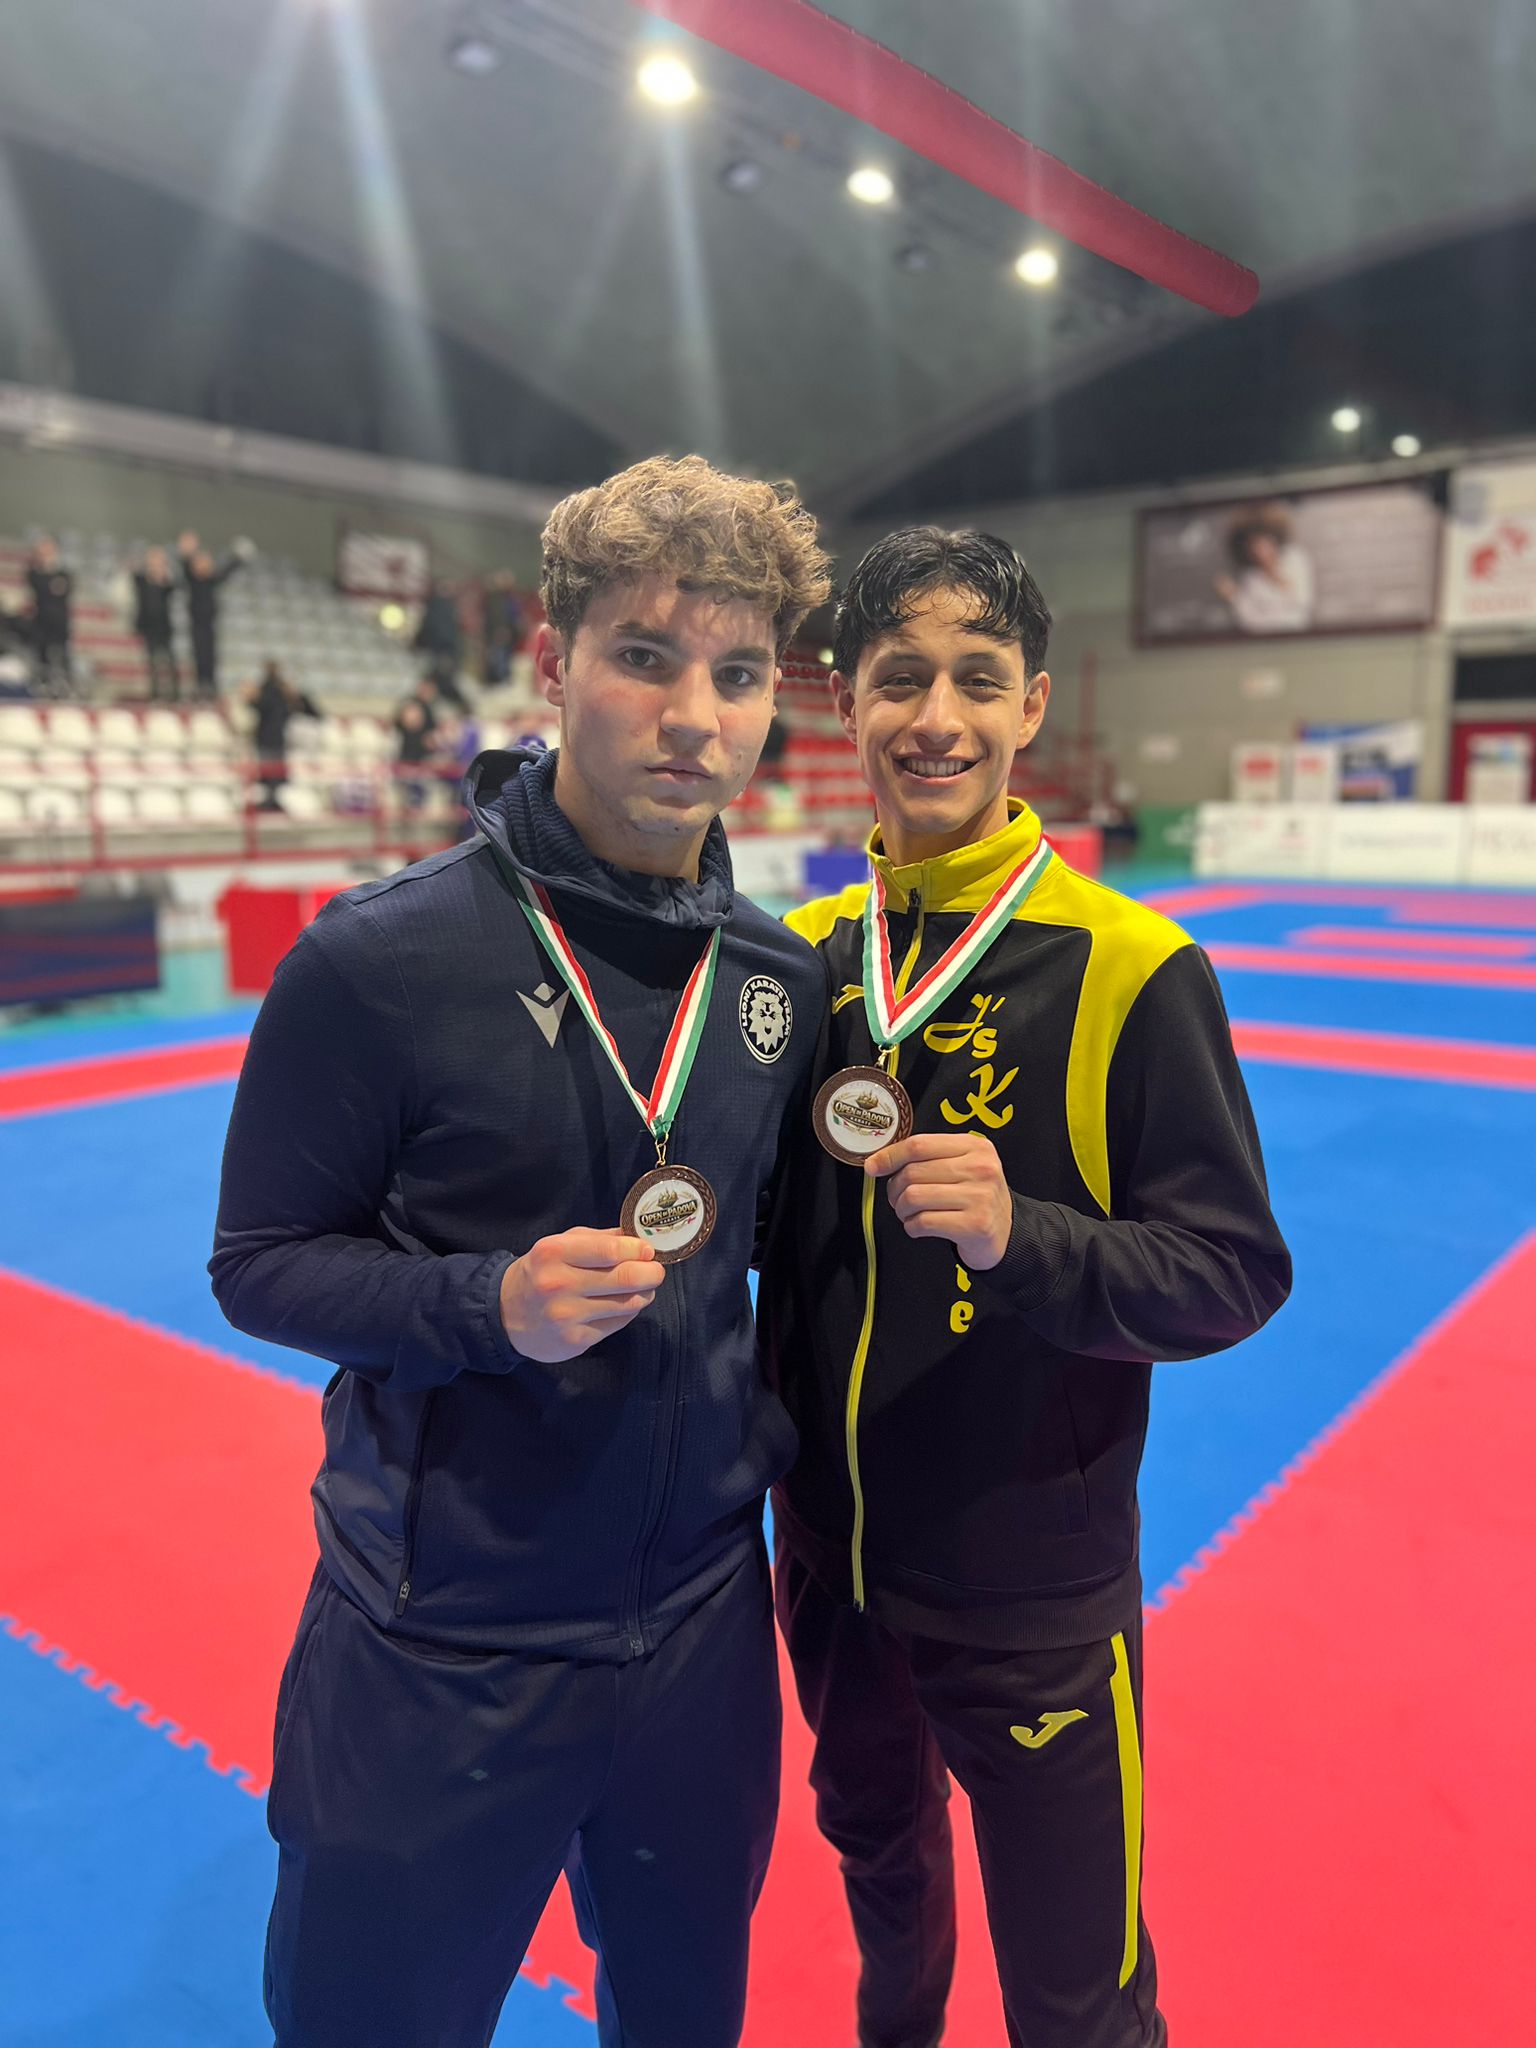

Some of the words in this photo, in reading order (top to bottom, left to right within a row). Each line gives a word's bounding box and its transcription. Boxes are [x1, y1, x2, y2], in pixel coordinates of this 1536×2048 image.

[741, 988, 752, 1027] LEONI
[750, 978, 785, 999] KARATE
[835, 1101, 856, 1116] OPEN
[861, 1109, 891, 1127] PADOVA
[641, 1210, 664, 1225] OPEN
[667, 1200, 697, 1217] PADOVA
